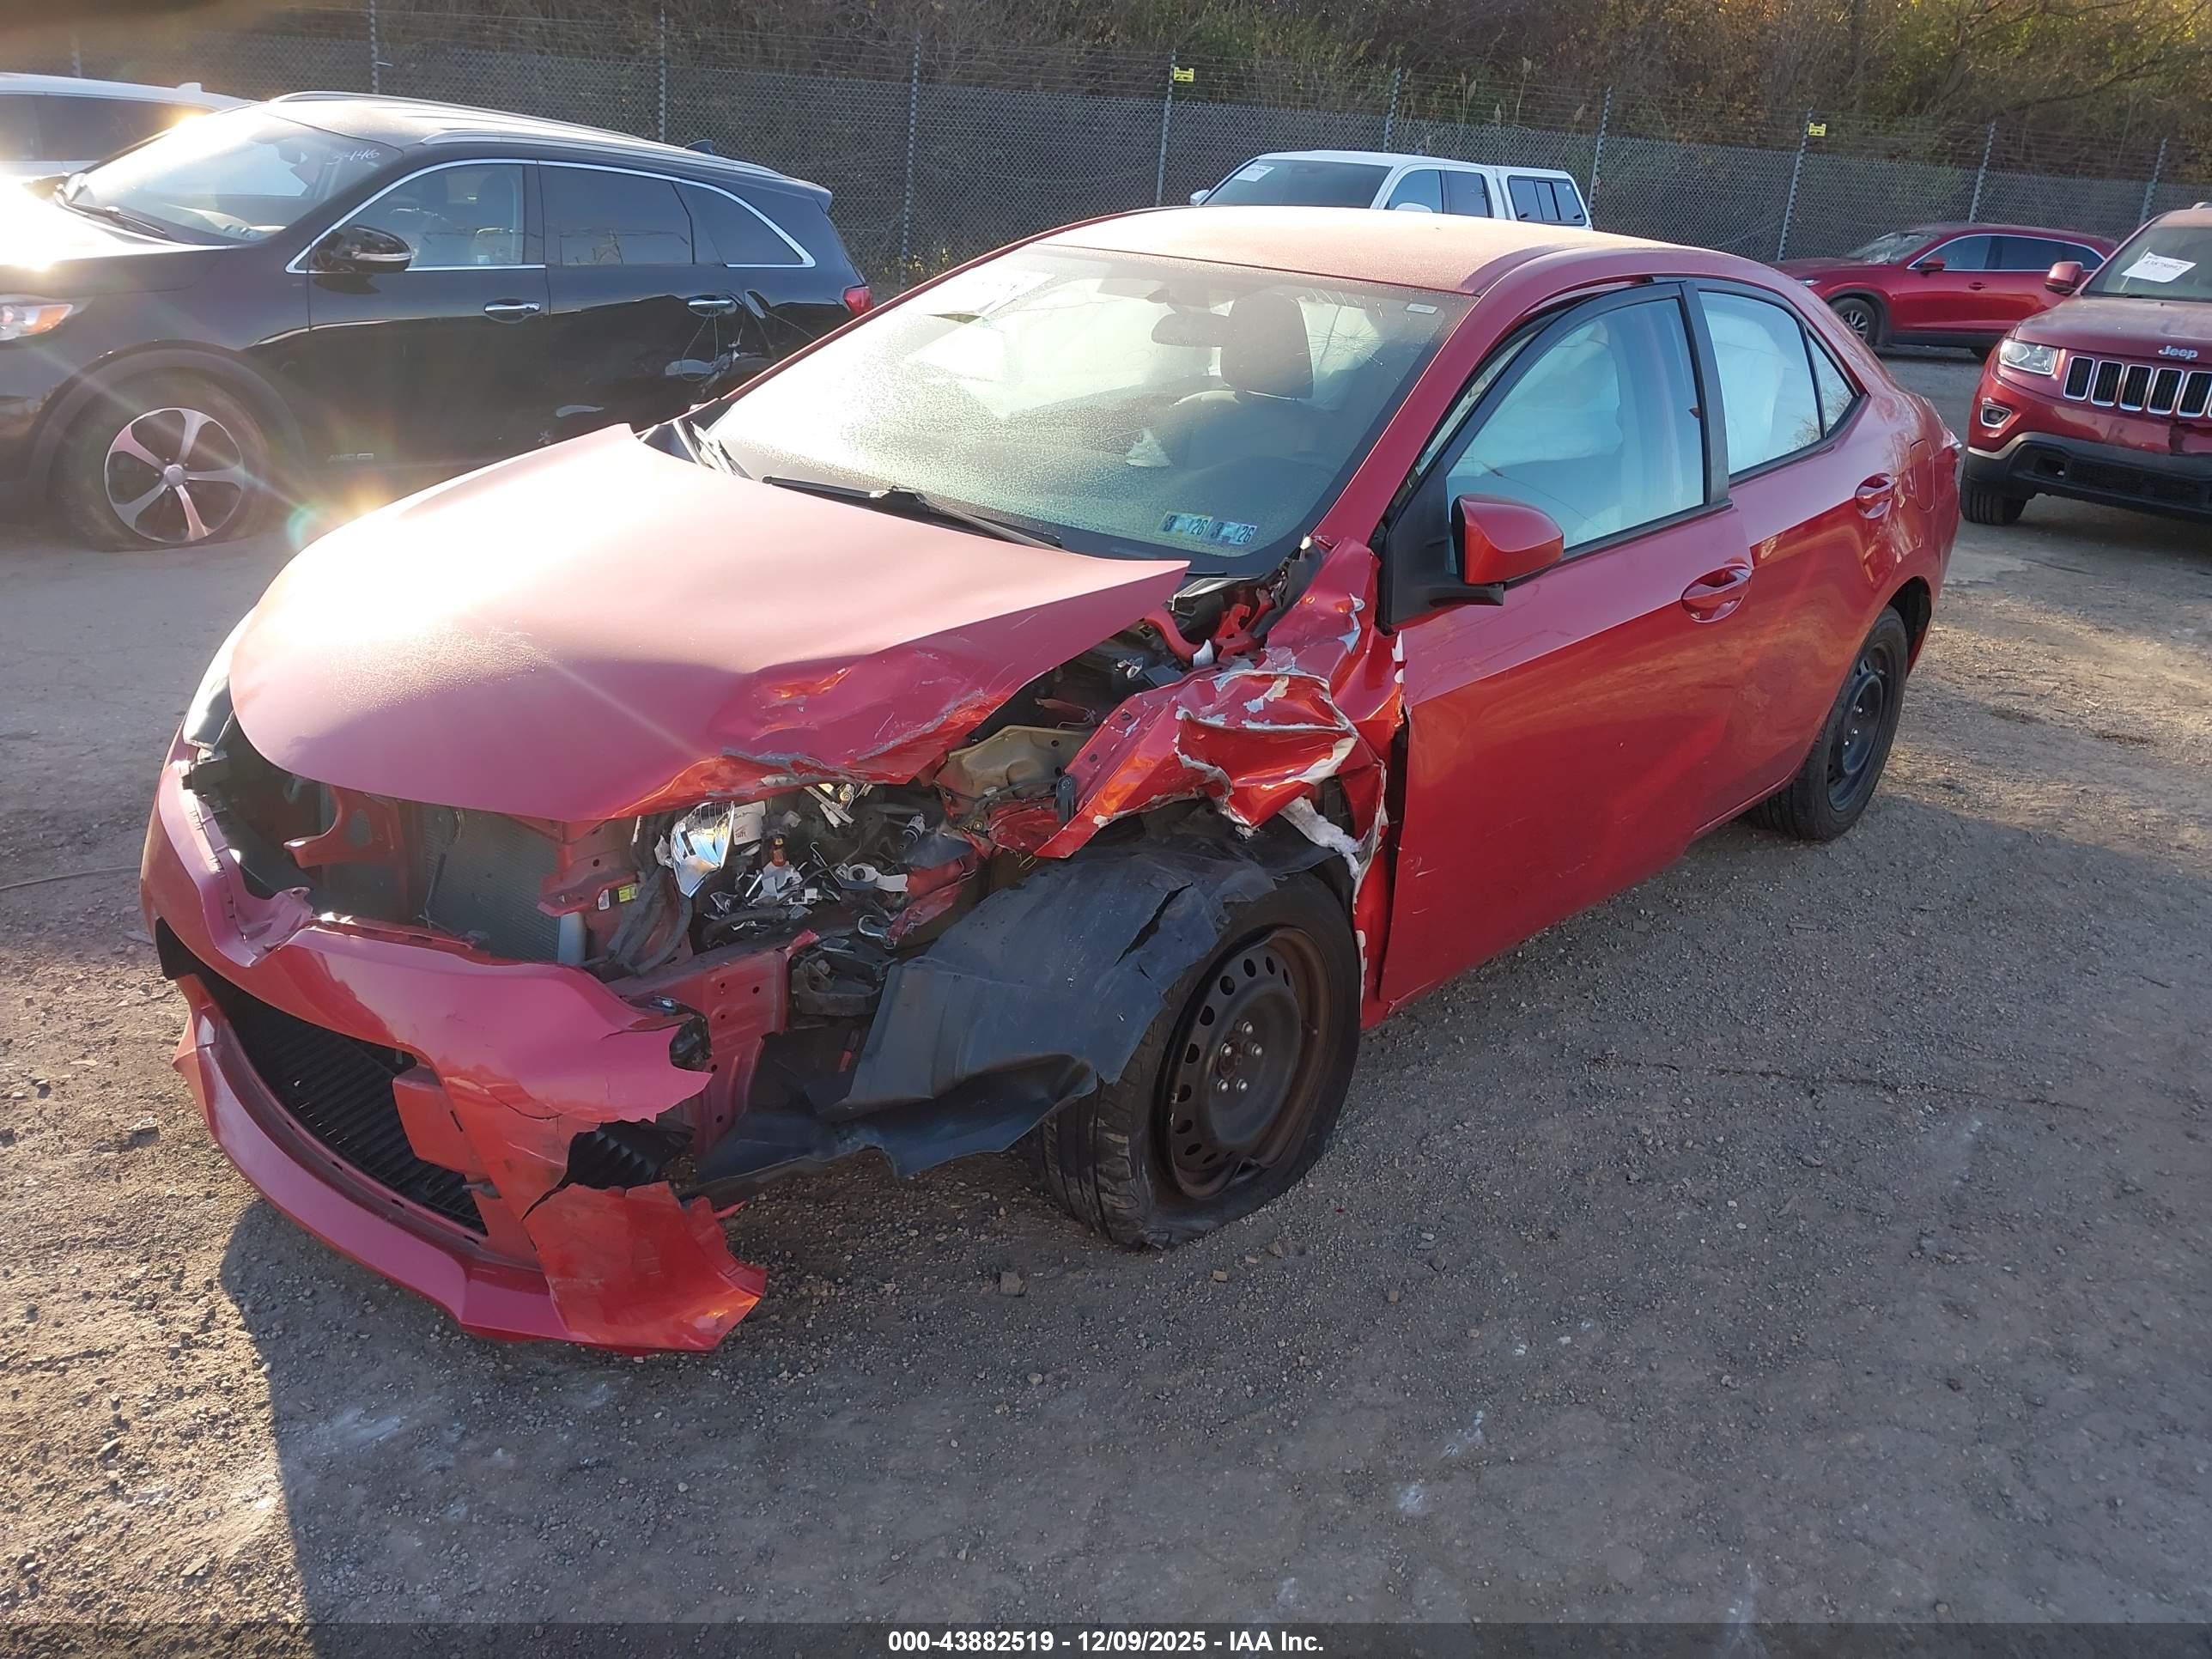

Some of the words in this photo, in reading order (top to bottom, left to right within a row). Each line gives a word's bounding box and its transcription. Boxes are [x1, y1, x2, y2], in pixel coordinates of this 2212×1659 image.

[2158, 345, 2198, 359] Jeep
[1191, 518, 1208, 536] 26
[1237, 526, 1255, 543] 26
